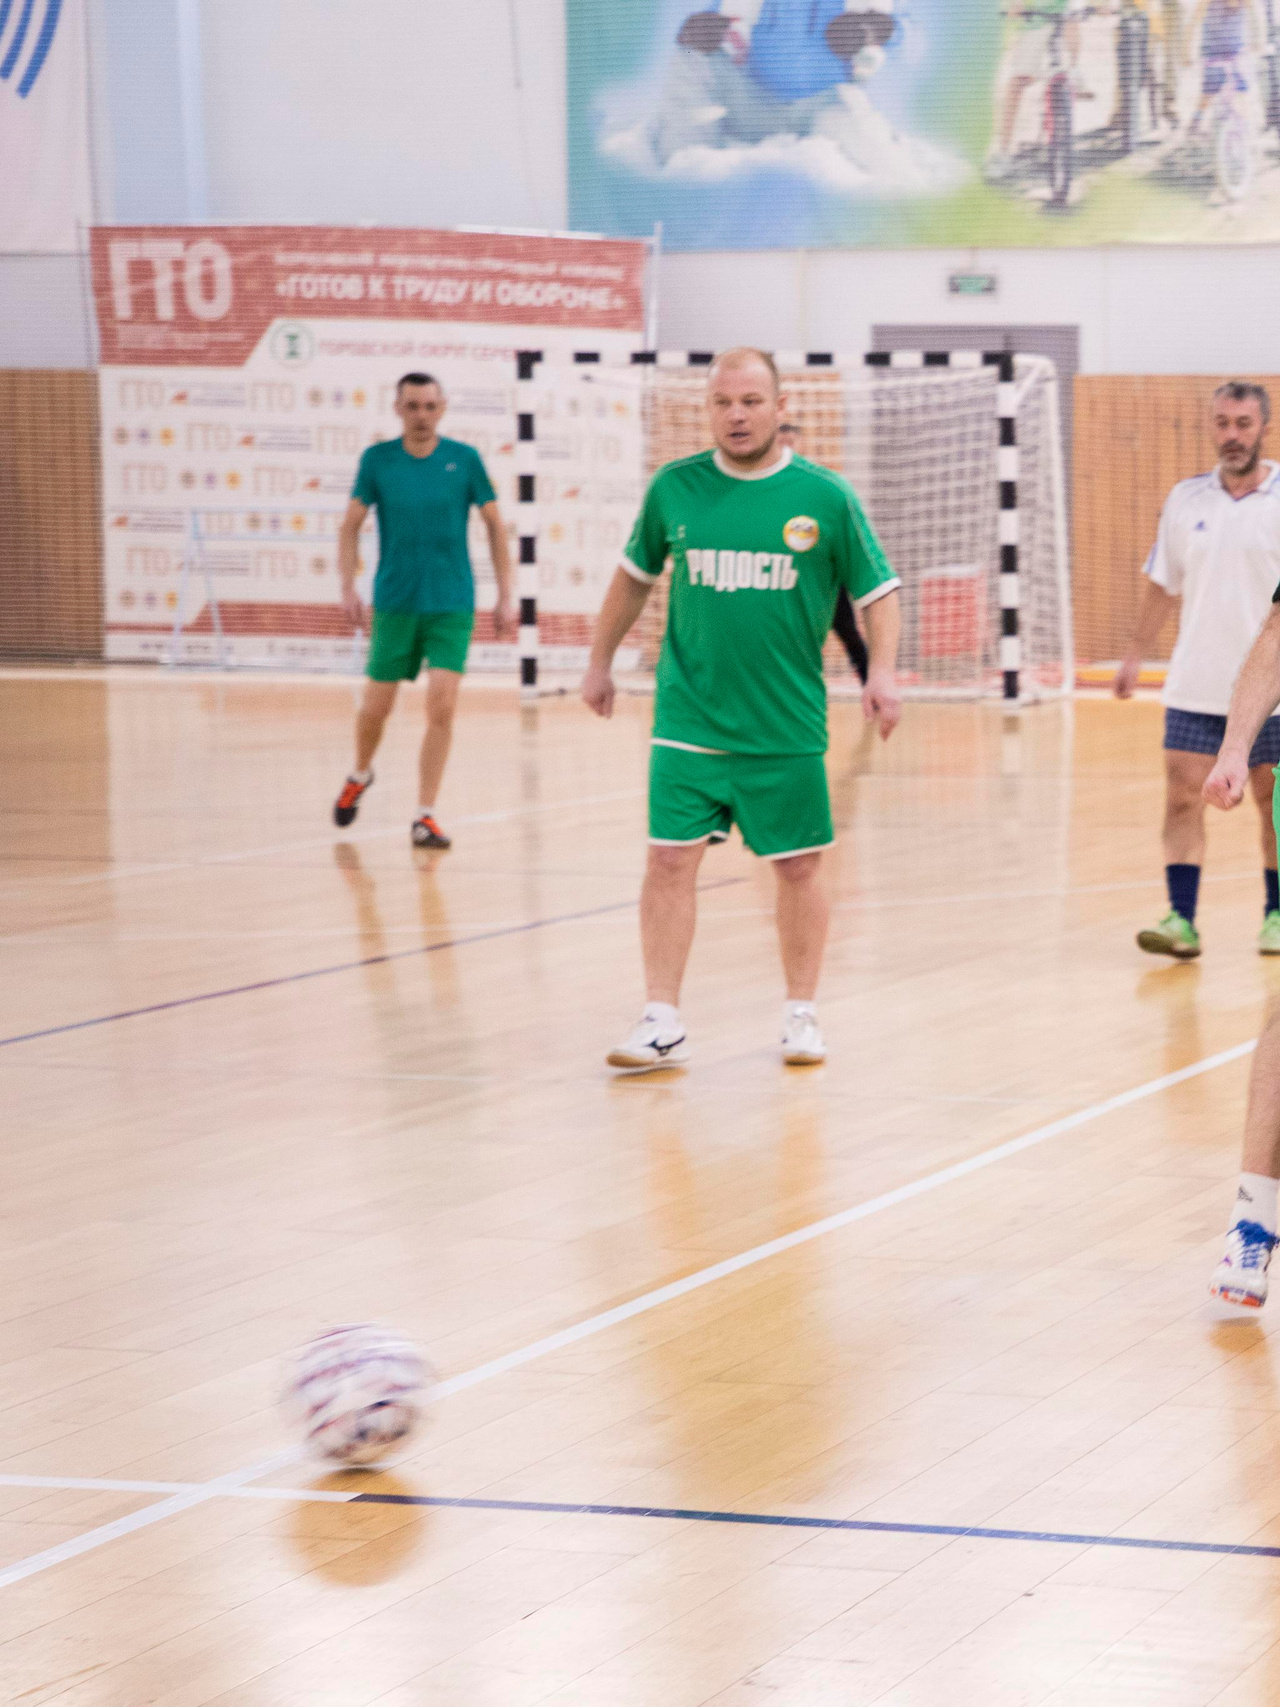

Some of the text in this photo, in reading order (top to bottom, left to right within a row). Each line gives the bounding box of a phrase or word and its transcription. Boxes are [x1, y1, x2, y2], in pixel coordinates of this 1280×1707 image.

[109, 238, 233, 321] ГТО
[368, 276, 386, 300] К
[394, 276, 470, 306] ТРУДУ
[471, 281, 493, 304] И
[685, 548, 799, 592] РАДОСТЬ
